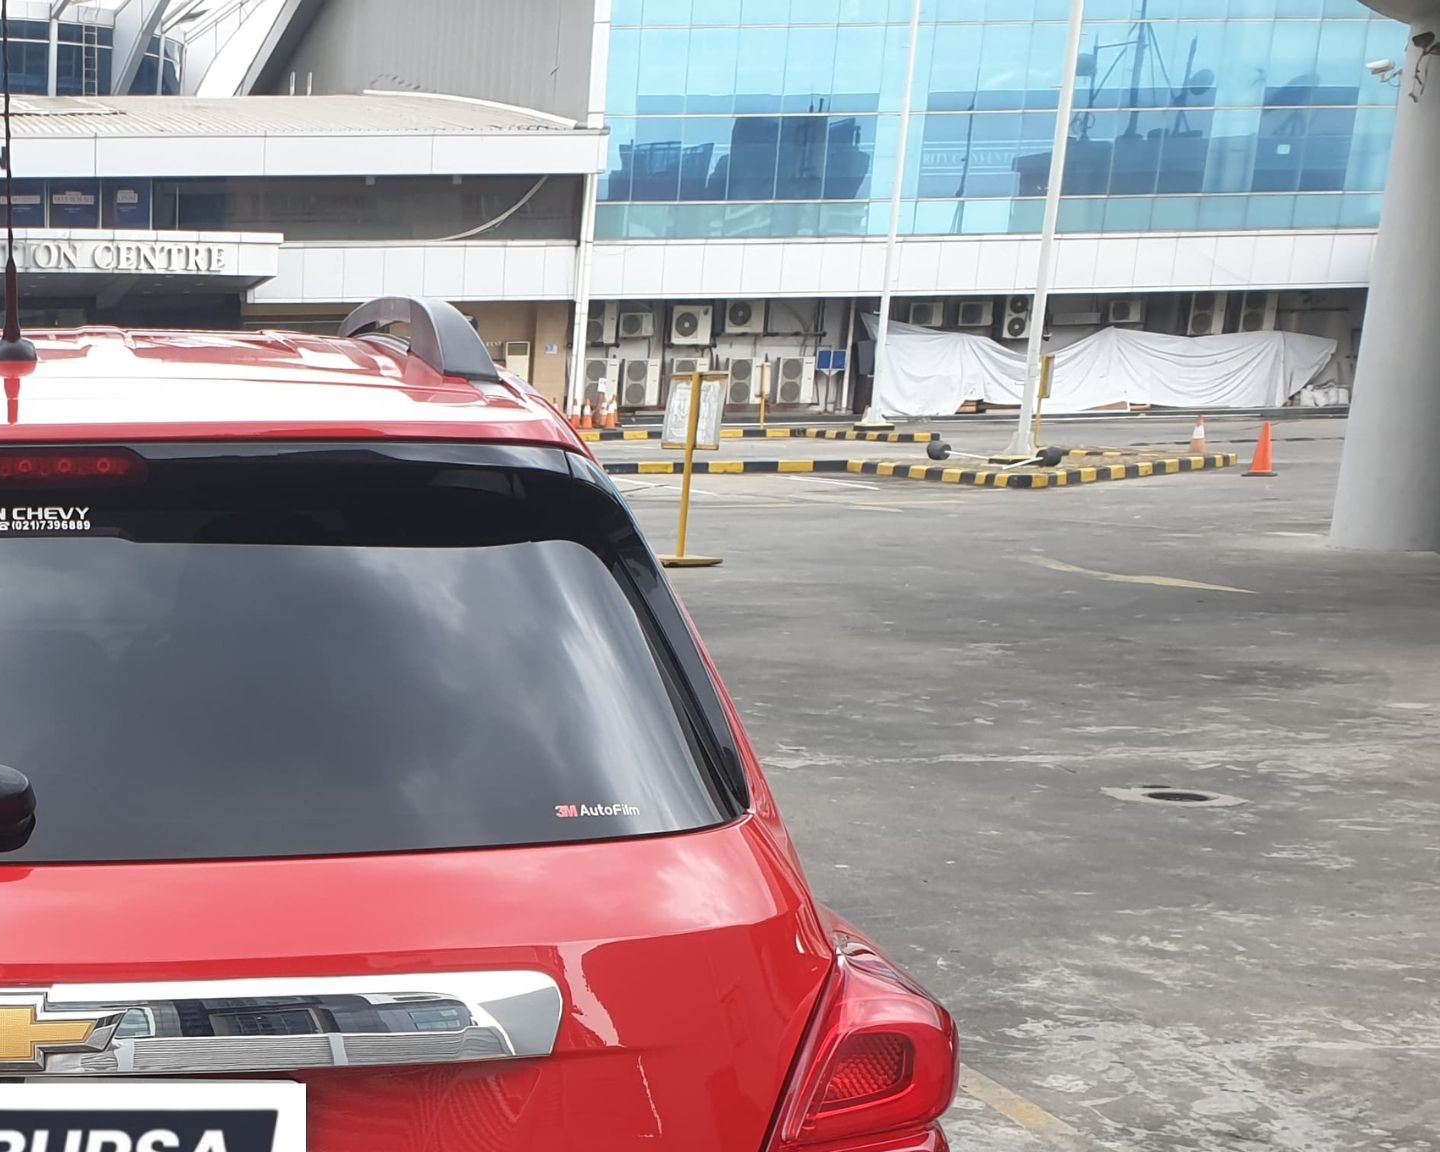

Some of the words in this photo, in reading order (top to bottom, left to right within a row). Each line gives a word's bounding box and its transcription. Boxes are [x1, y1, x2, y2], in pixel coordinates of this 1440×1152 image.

[92, 243, 226, 271] CENTRE
[12, 507, 90, 521] CHEVY
[11, 520, 91, 531] (021)7396889
[554, 805, 578, 818] 3M
[579, 804, 641, 817] AutoFilm
